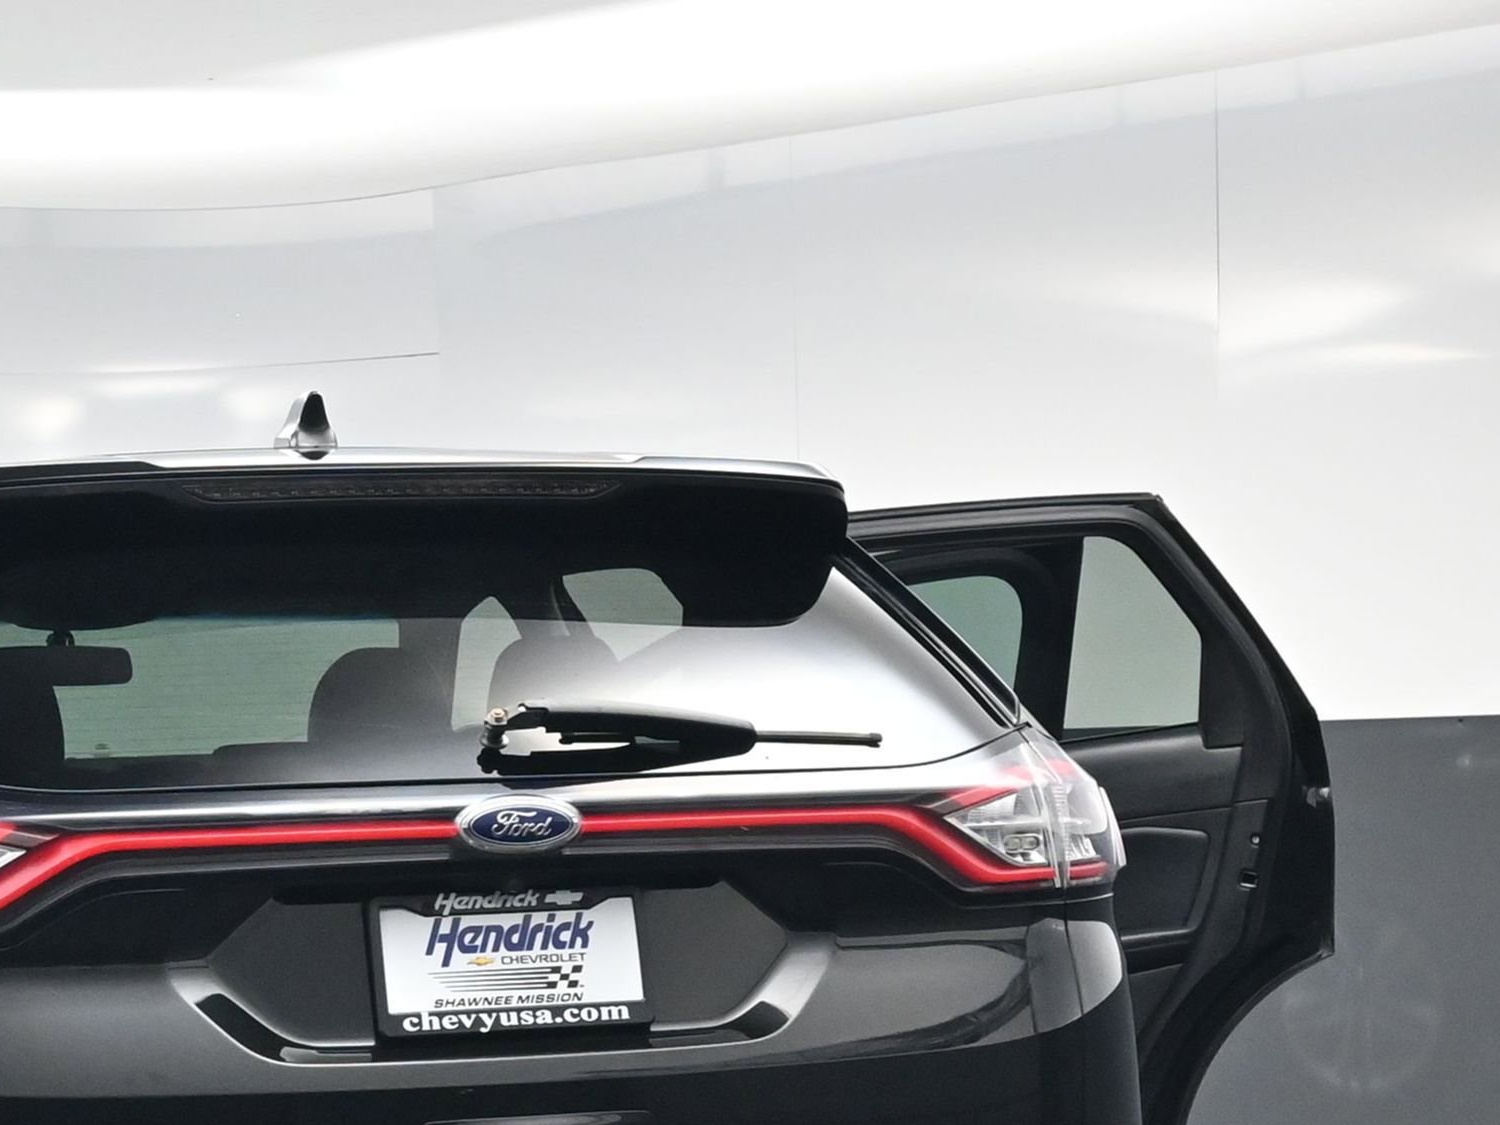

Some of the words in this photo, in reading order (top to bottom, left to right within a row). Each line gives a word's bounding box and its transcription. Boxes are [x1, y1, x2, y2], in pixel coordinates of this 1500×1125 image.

[492, 810, 552, 836] Ford
[434, 889, 540, 916] Hendrick
[425, 912, 594, 968] Hendrick
[501, 953, 586, 965] CHEVROLET
[434, 995, 514, 1009] SHAWNEE
[517, 992, 584, 1005] MISSION
[402, 1004, 630, 1033] chevyusa.com
